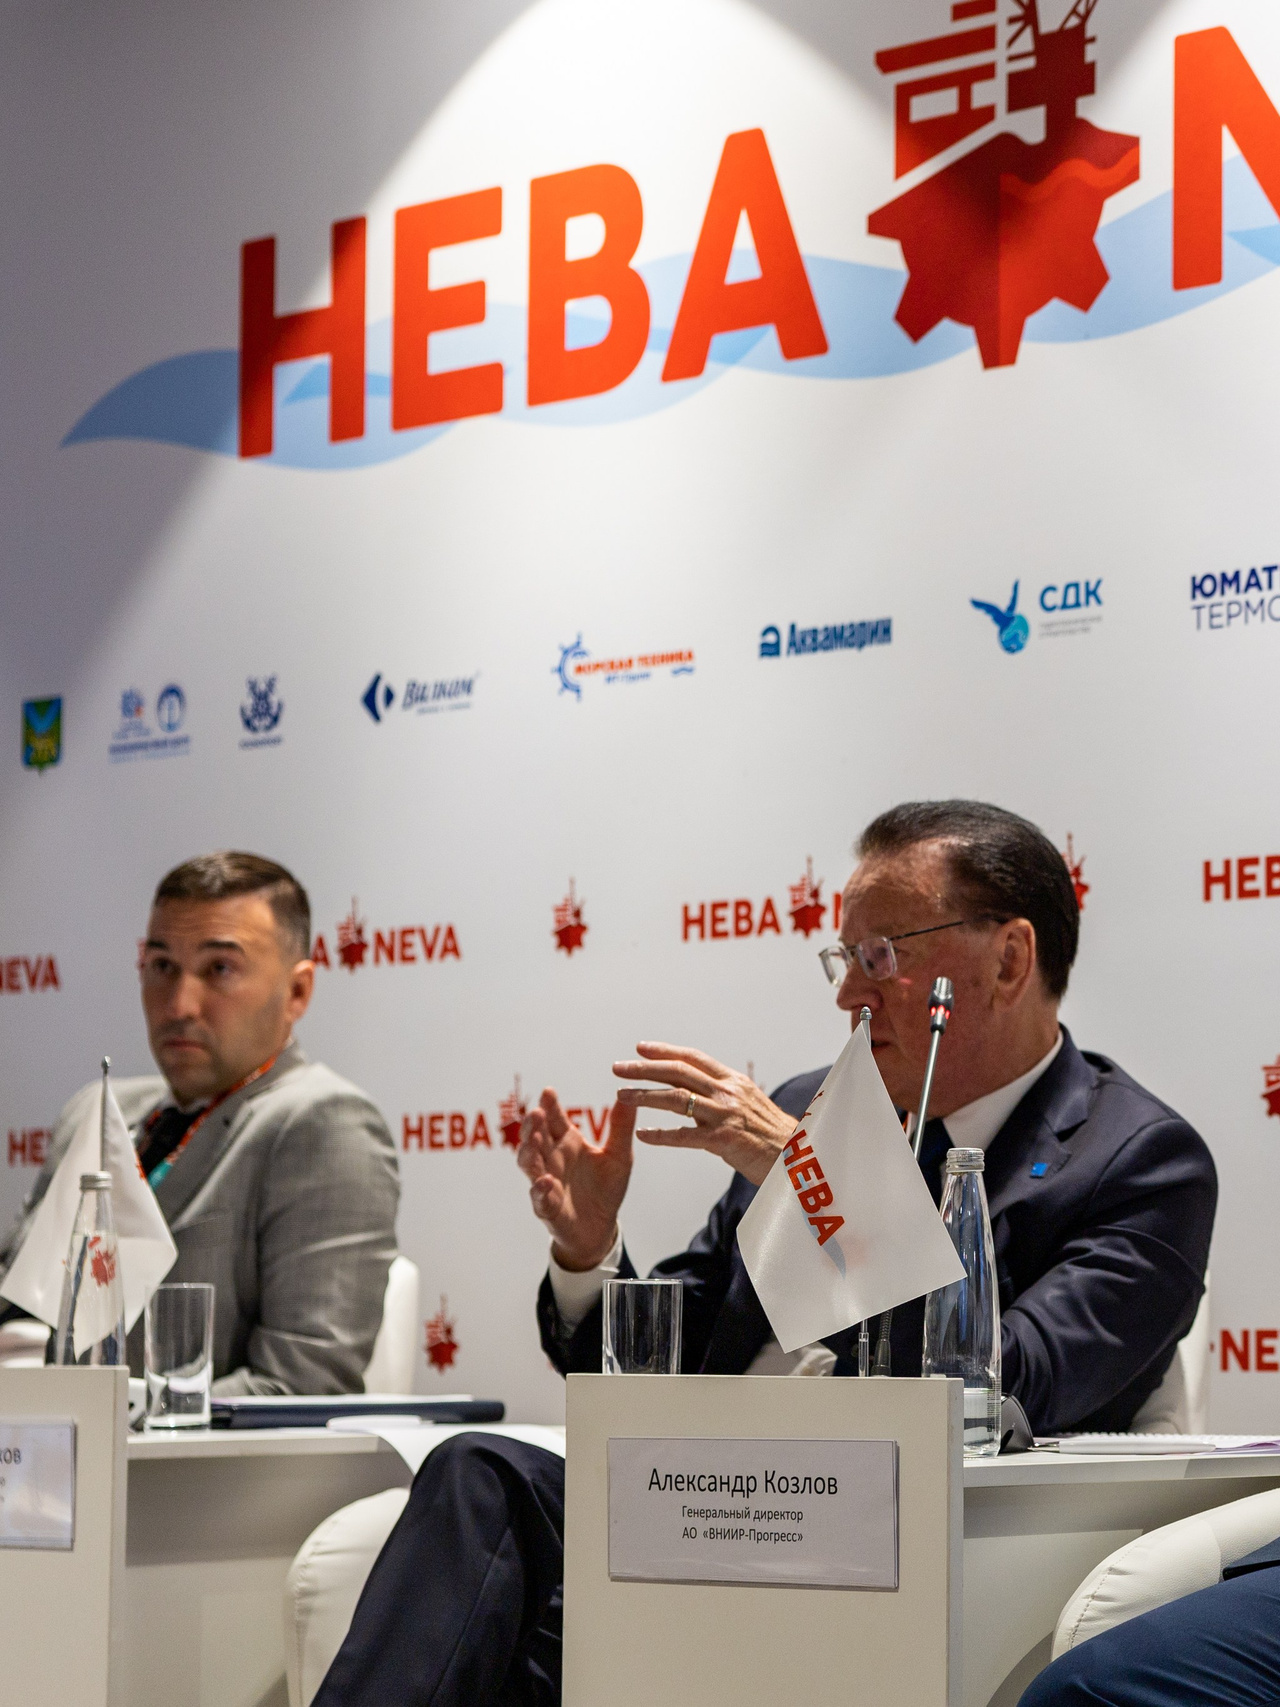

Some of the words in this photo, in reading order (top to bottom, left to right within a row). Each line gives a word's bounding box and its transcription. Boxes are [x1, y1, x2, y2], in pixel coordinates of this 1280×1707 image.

[239, 127, 830, 460] НЕВА
[1038, 577, 1104, 613] СДК
[682, 897, 782, 942] НЕВА
[373, 924, 462, 965] NEVA
[0, 955, 61, 994] EVA
[8, 1128, 51, 1167] НЕ
[402, 1111, 493, 1151] НЕВА
[782, 1128, 846, 1247] НЕВА
[647, 1467, 758, 1499] Александр
[763, 1469, 839, 1496] Козлов
[681, 1505, 751, 1520] Генеральный
[752, 1508, 804, 1522] директор
[681, 1526, 698, 1540] АО
[702, 1527, 804, 1545] «ВНИИР-Прогресс»
